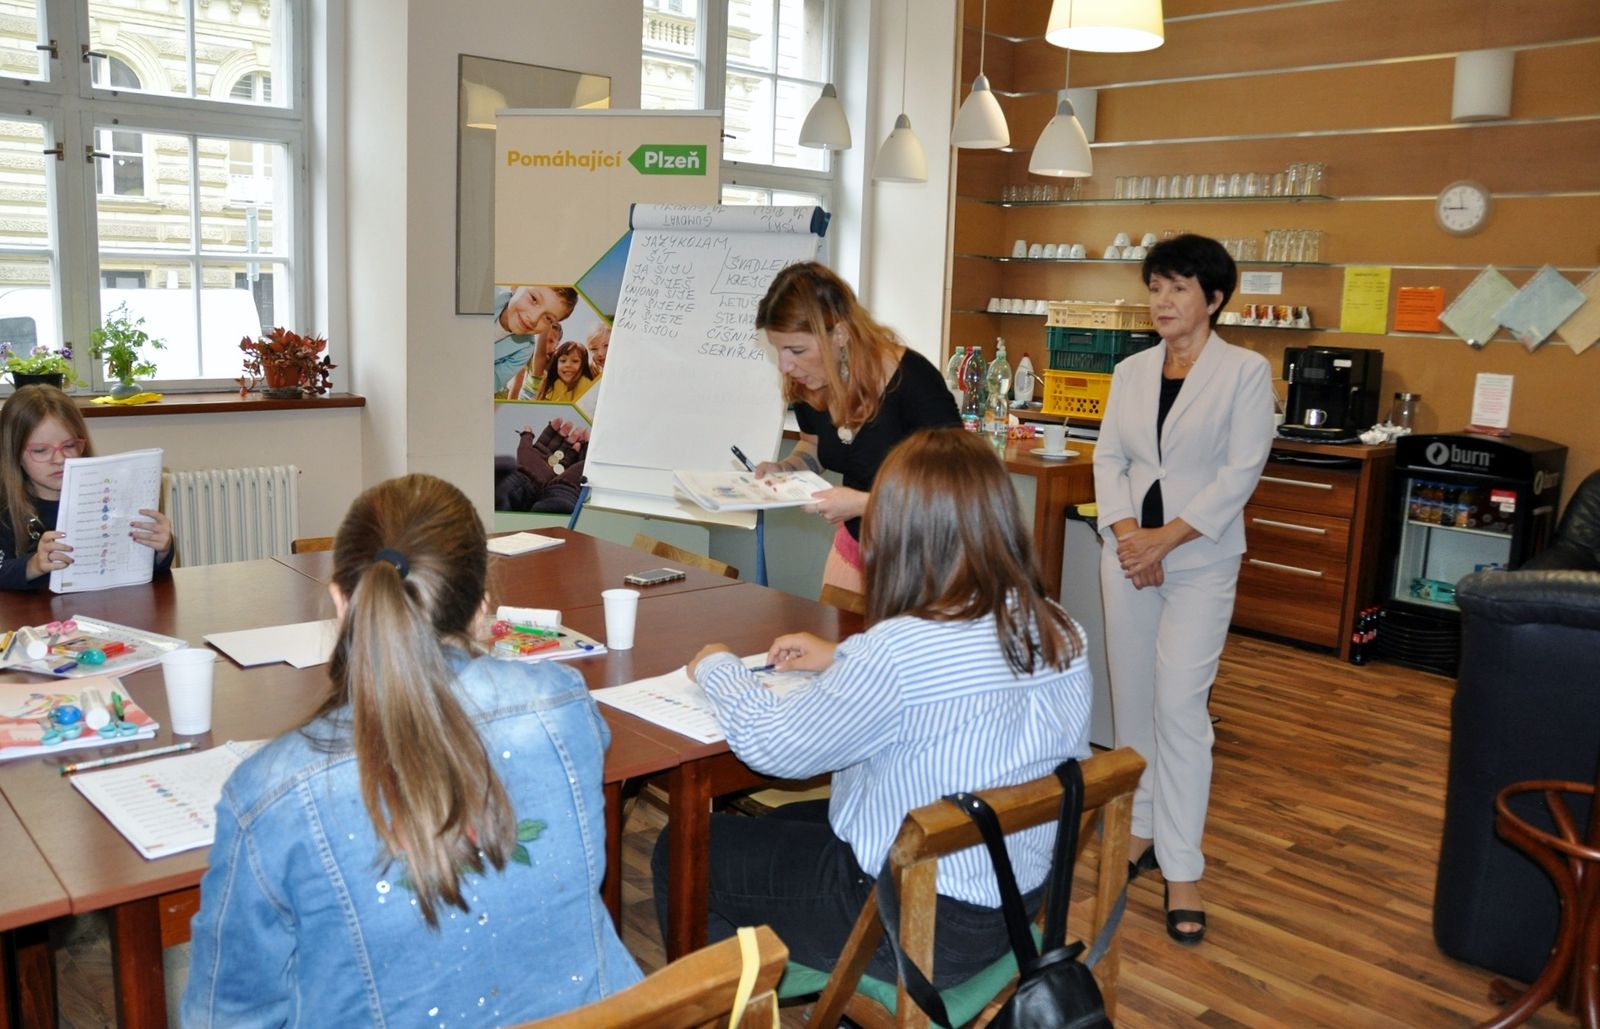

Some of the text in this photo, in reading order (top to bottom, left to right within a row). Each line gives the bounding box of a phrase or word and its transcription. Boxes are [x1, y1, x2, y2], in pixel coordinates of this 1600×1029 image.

[507, 150, 700, 172] Pomáhající Plzeň
[726, 273, 772, 288] KREJČ
[719, 294, 758, 311] LETUŠ
[712, 310, 757, 325] STEVAR
[1451, 444, 1490, 466] burn
